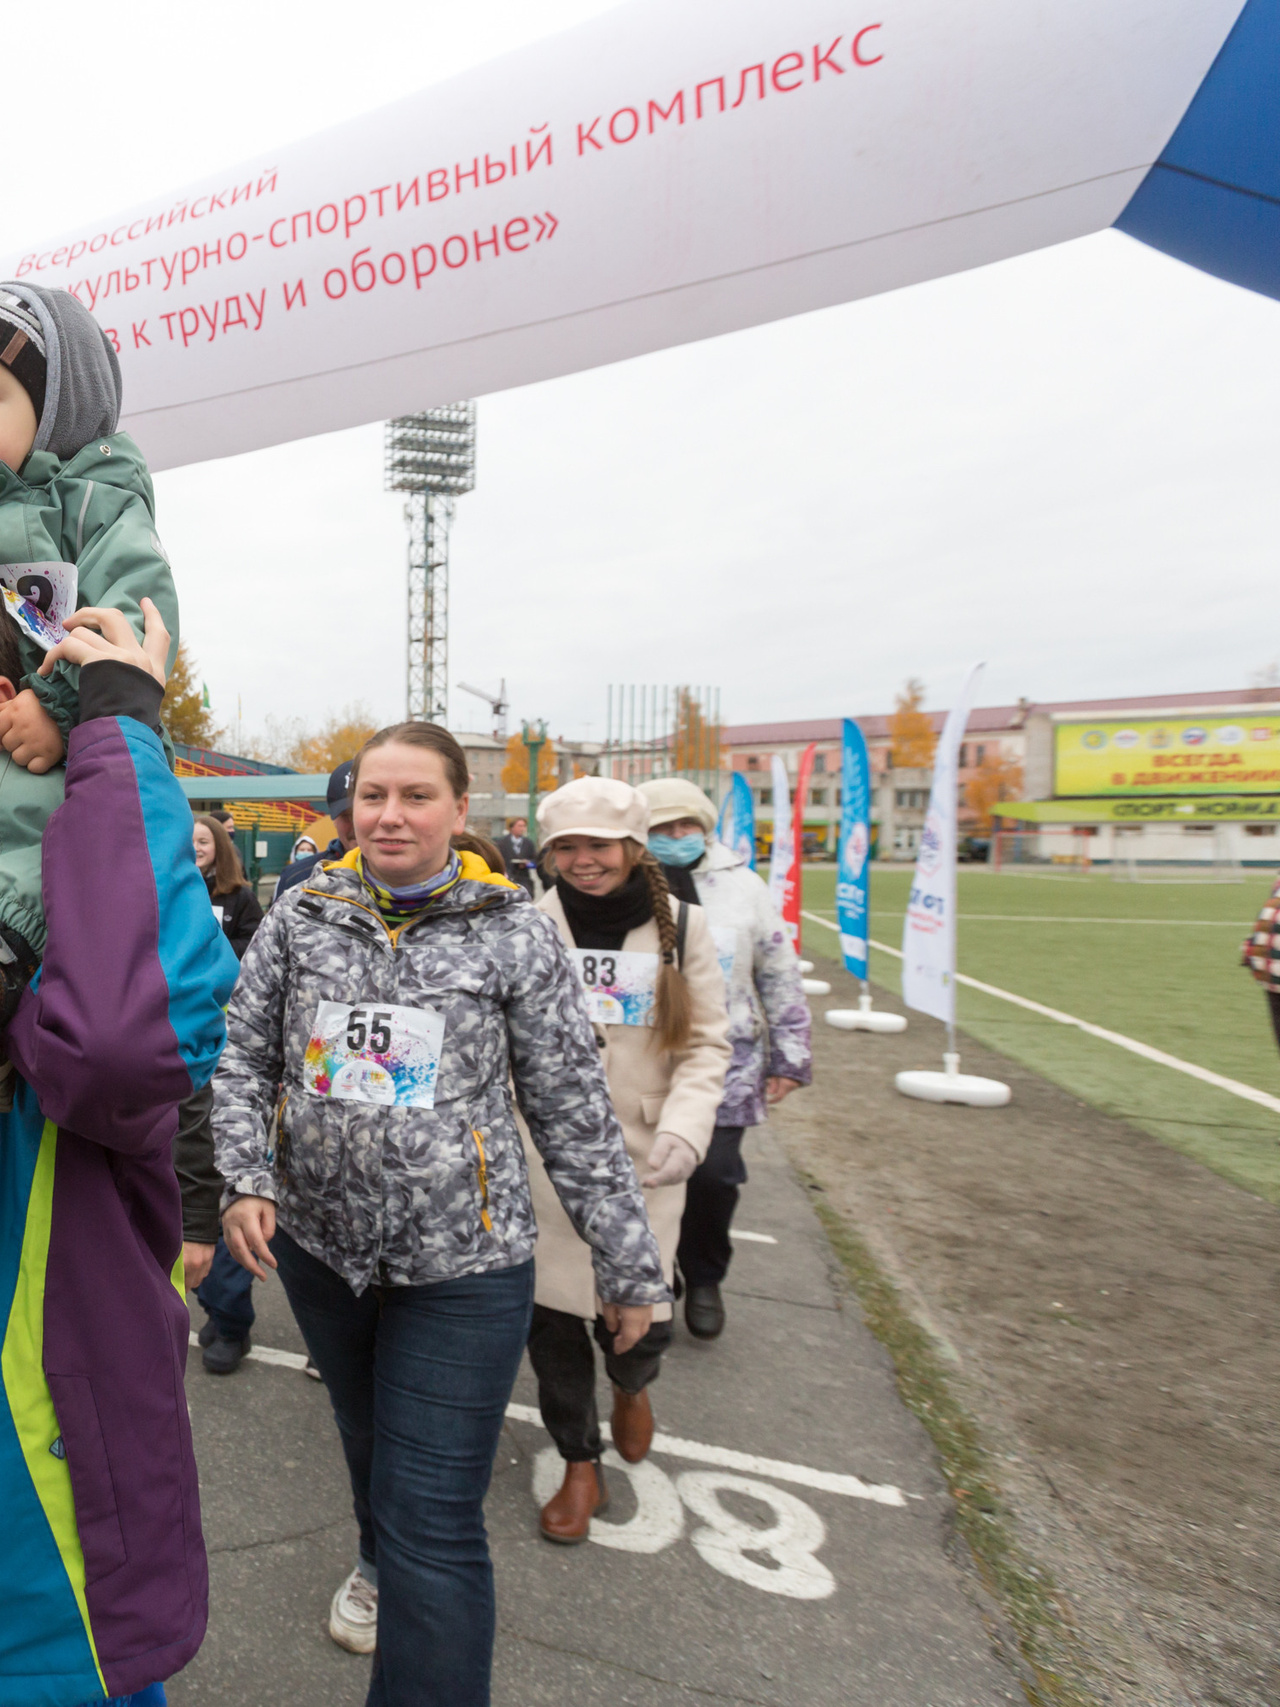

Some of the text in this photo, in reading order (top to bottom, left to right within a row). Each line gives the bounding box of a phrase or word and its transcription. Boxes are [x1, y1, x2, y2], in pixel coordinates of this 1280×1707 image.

[68, 22, 886, 312] культурно-спортивный комплекс
[15, 166, 279, 278] Всероссийский
[132, 318, 152, 350] к
[160, 287, 267, 347] труду
[285, 277, 307, 311] и
[323, 210, 560, 300] обороне»
[1151, 752, 1245, 769] ВСЕГДА
[582, 955, 616, 987] 83
[346, 1010, 393, 1054] 55
